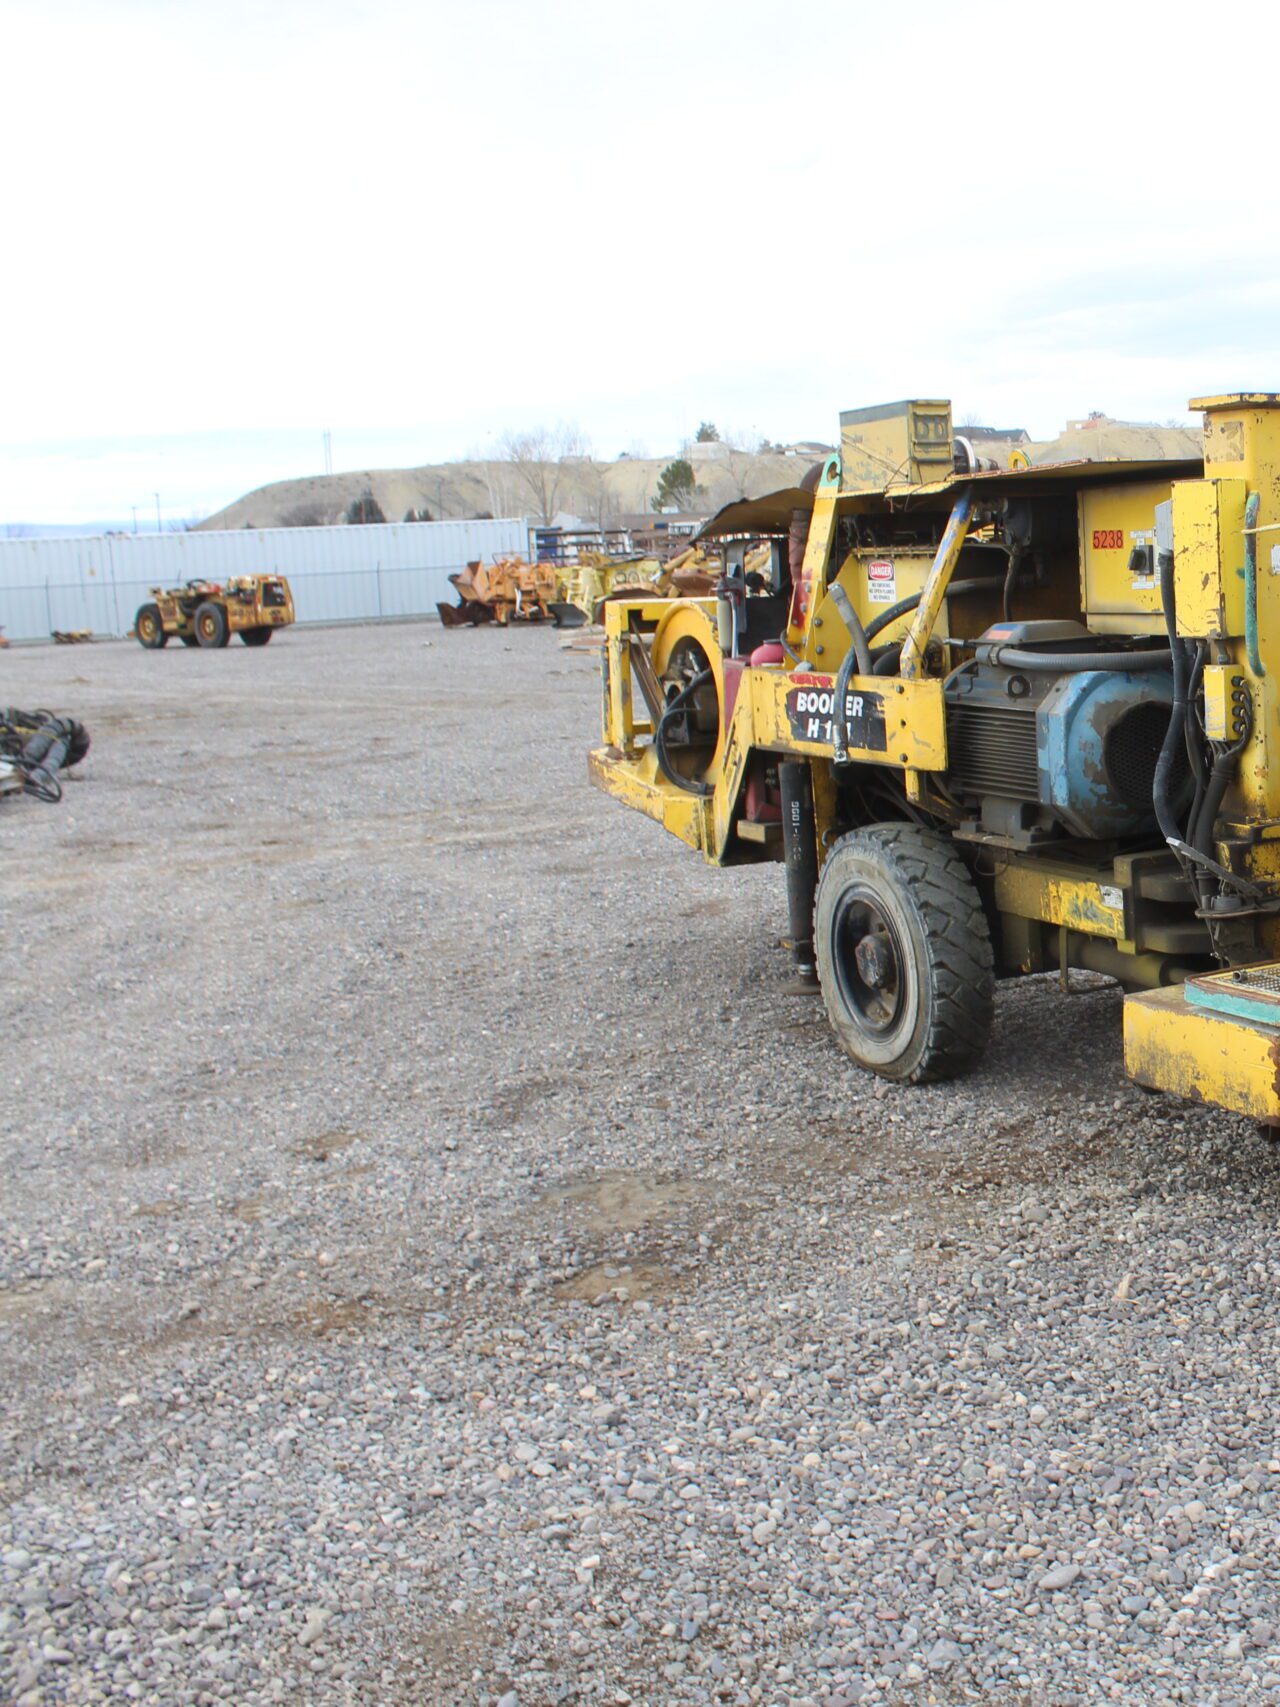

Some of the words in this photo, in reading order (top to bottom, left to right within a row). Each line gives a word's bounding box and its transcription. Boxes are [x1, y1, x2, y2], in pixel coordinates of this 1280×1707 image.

[1093, 530, 1123, 549] 5238
[870, 565, 892, 576] DANGER
[797, 692, 863, 717] BOOER
[807, 718, 820, 738] H
[824, 720, 851, 741] 11
